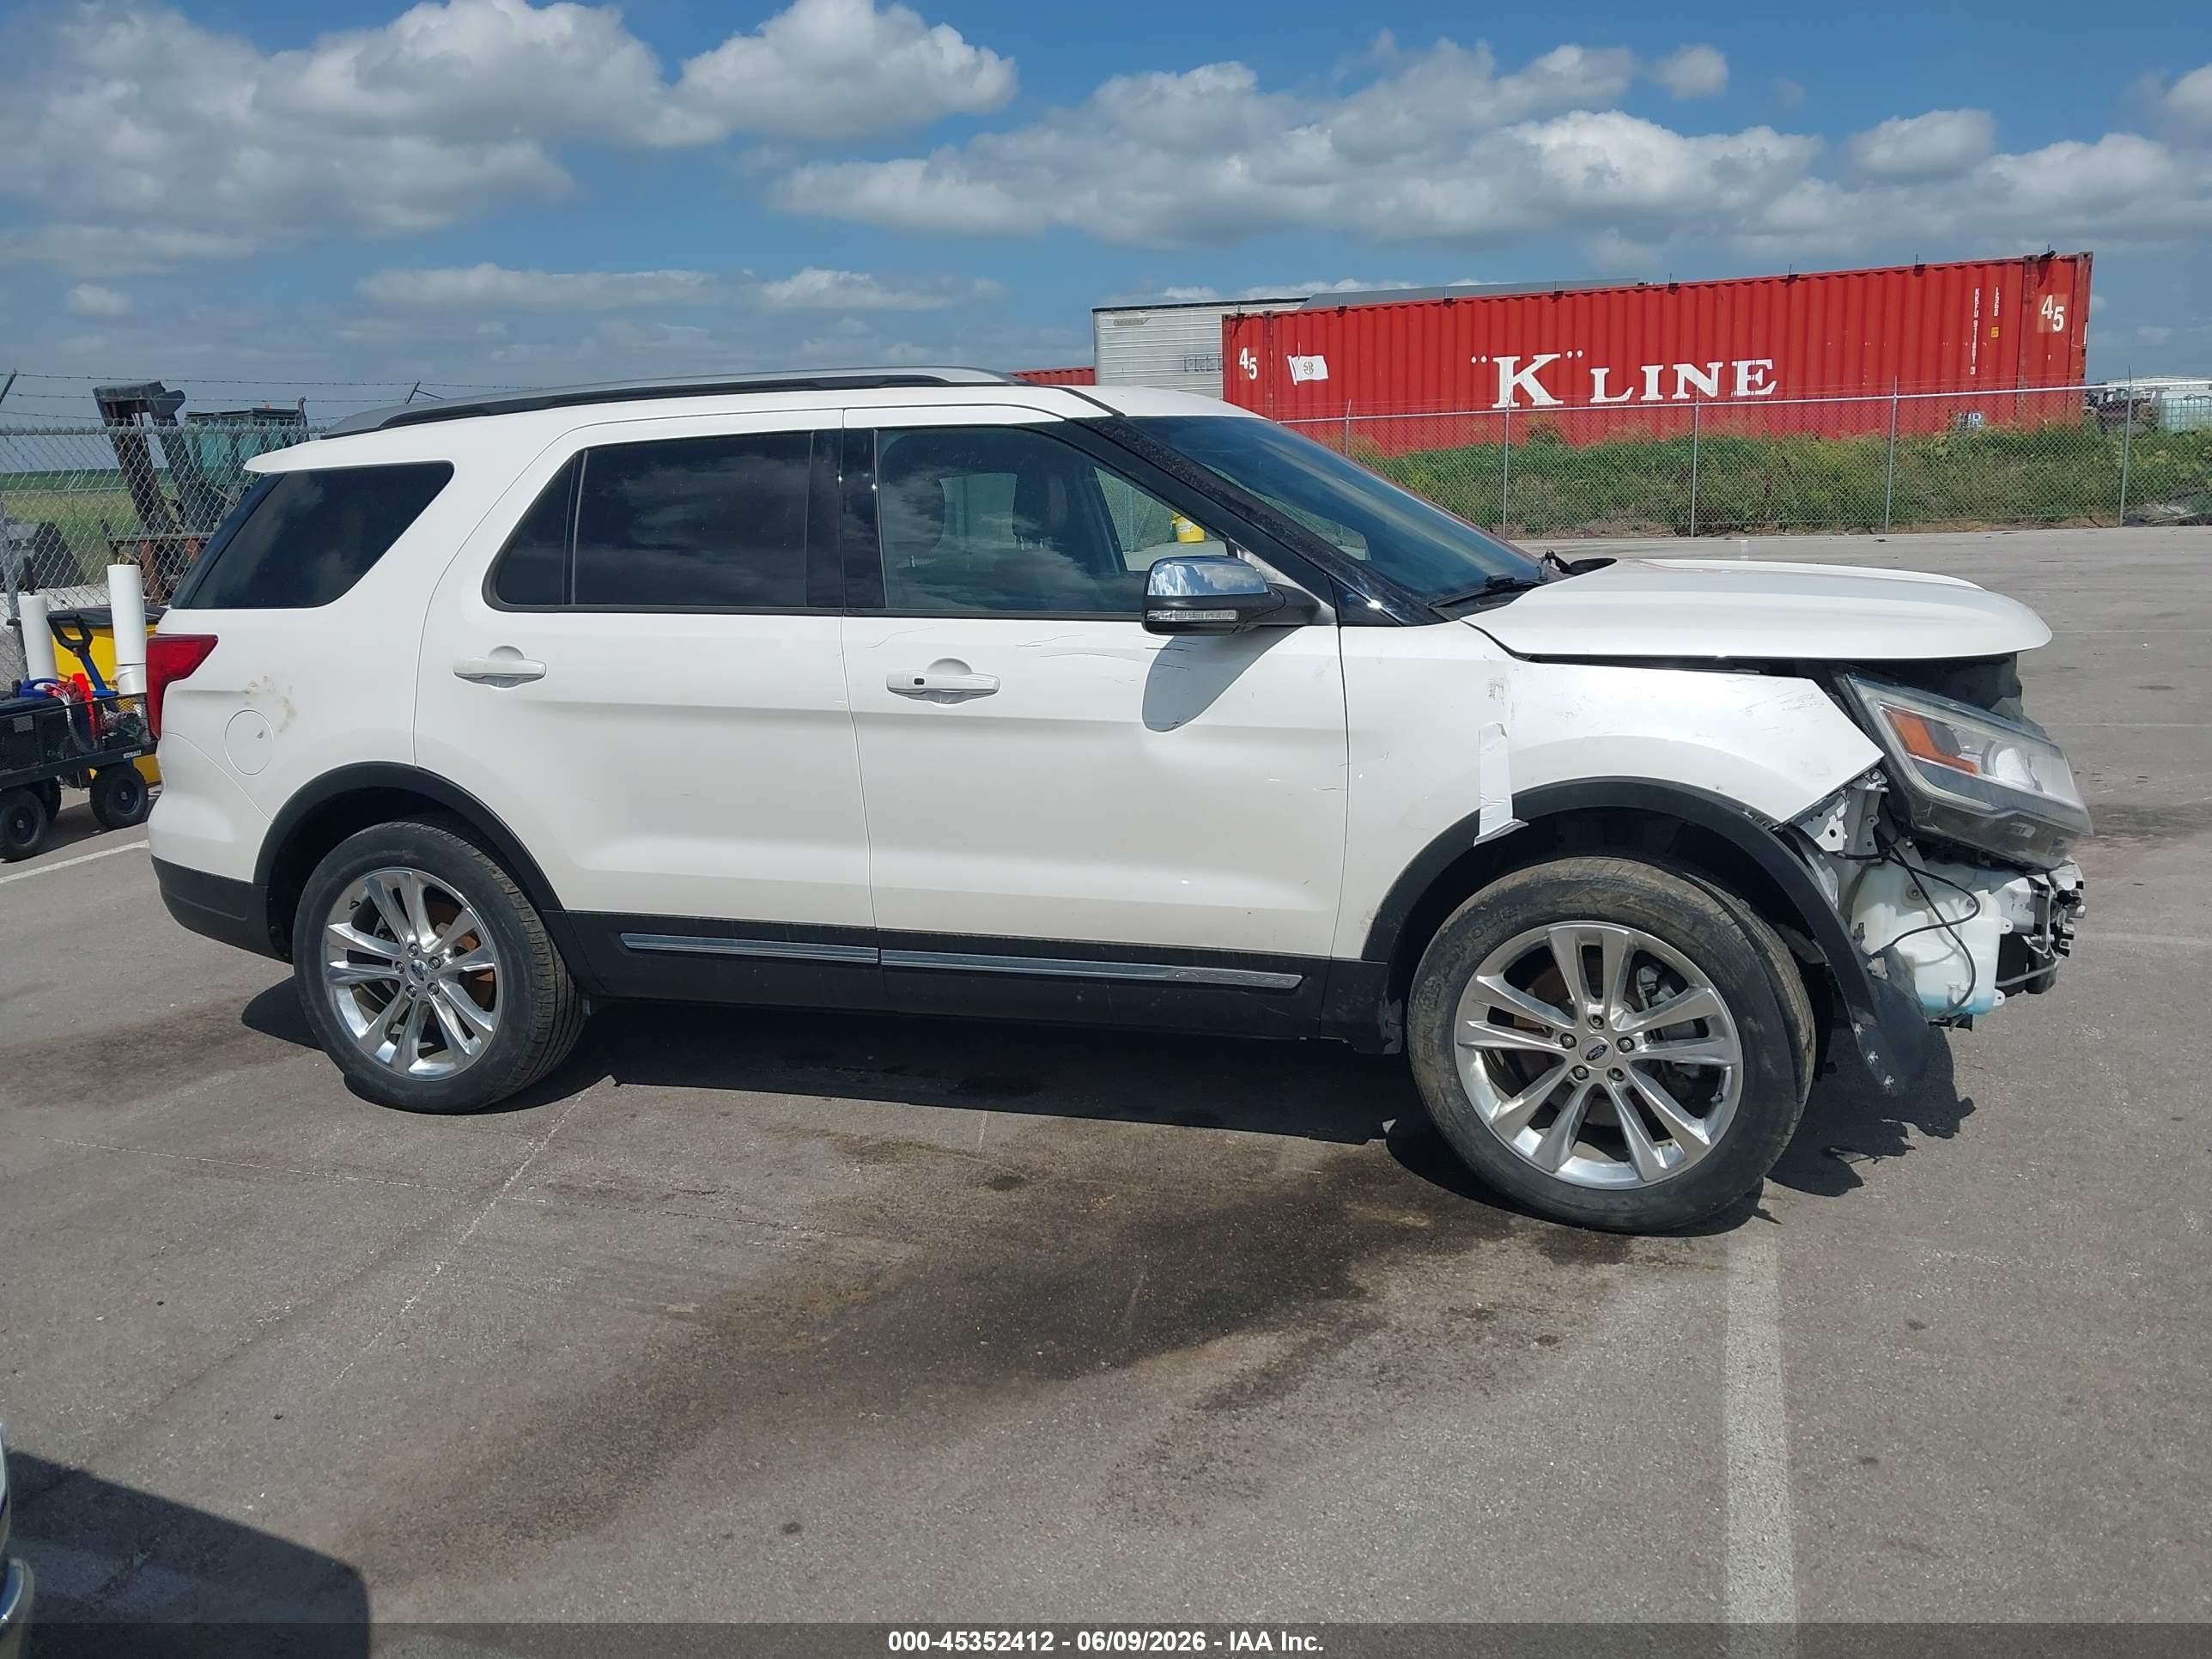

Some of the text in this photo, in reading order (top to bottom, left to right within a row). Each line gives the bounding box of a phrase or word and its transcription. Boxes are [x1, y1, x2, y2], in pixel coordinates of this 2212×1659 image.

[2041, 295, 2065, 332] 45
[1239, 347, 1258, 380] 45
[1589, 358, 1778, 404] LINE
